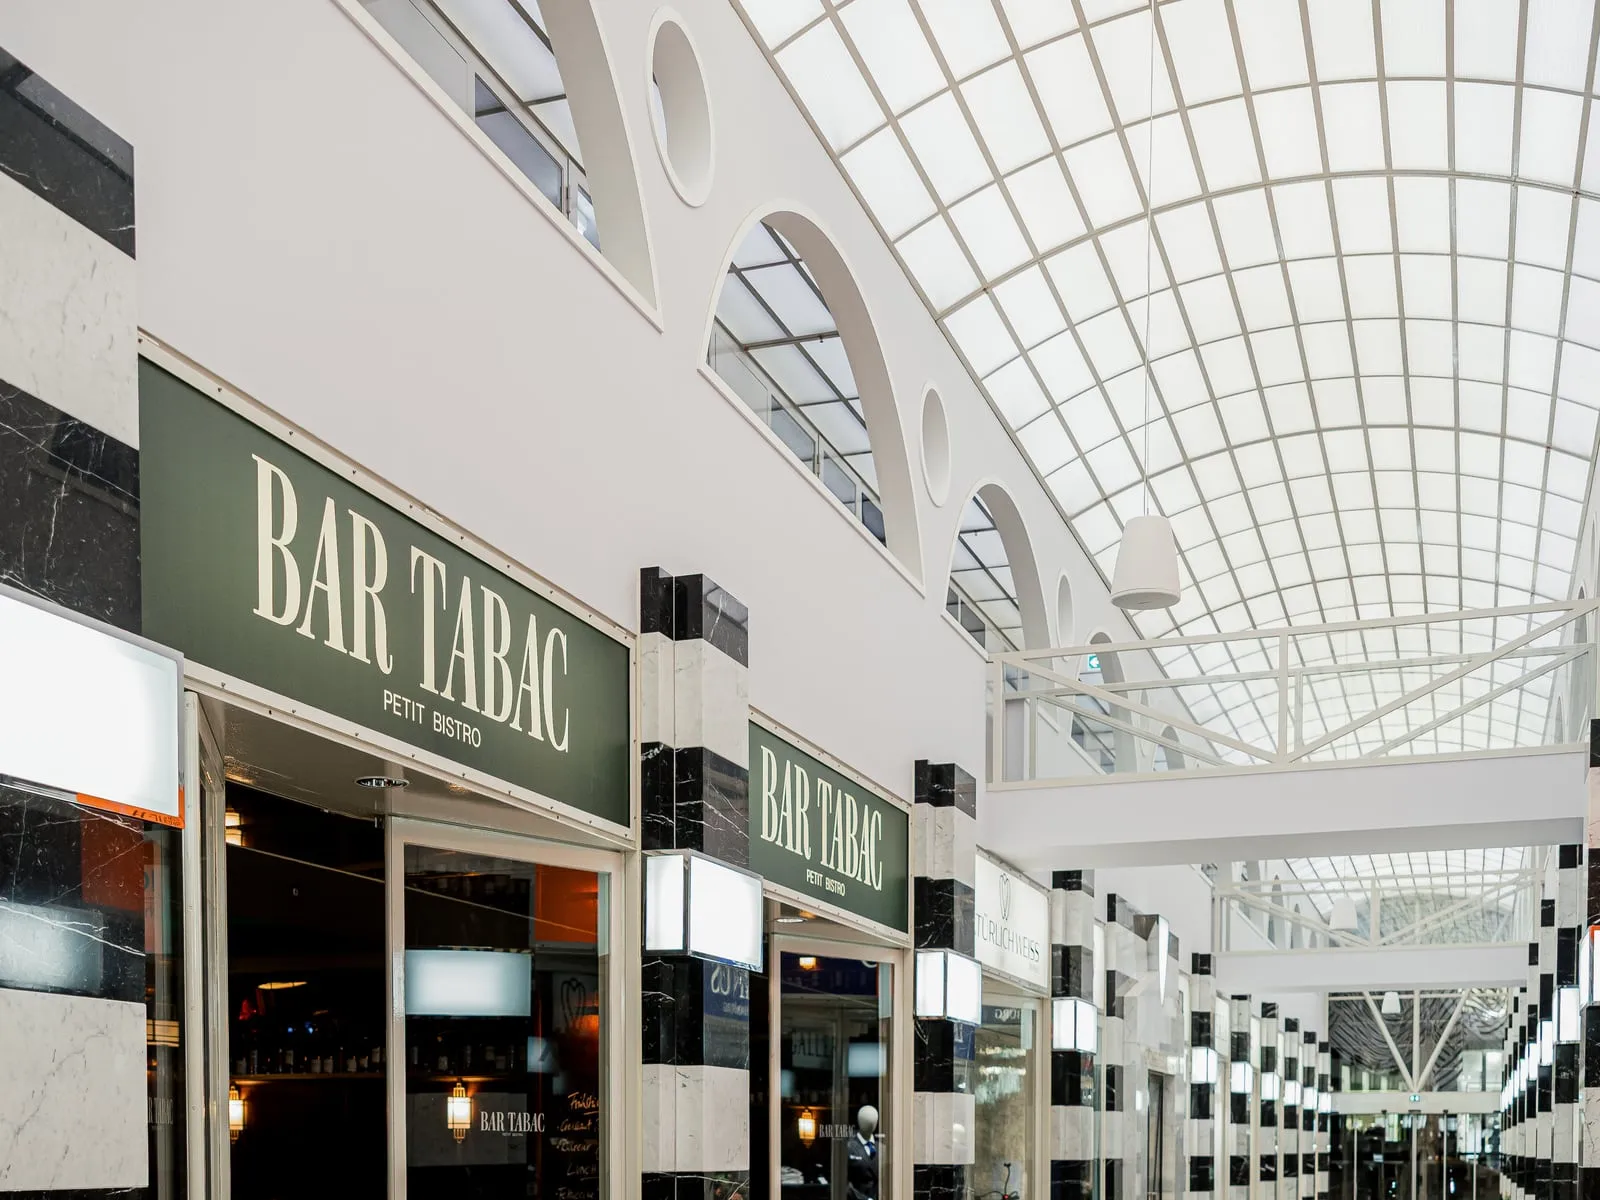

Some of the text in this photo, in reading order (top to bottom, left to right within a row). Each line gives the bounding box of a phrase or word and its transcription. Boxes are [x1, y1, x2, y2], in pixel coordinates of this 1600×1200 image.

[252, 453, 569, 753] BAR TABAC
[384, 689, 481, 748] PETIT BISTRO
[760, 745, 882, 891] BAR TABAC
[806, 869, 846, 896] PETIT BISTRO
[480, 1111, 545, 1132] BAR TABAC
[819, 1124, 856, 1138] BAR TABAC
